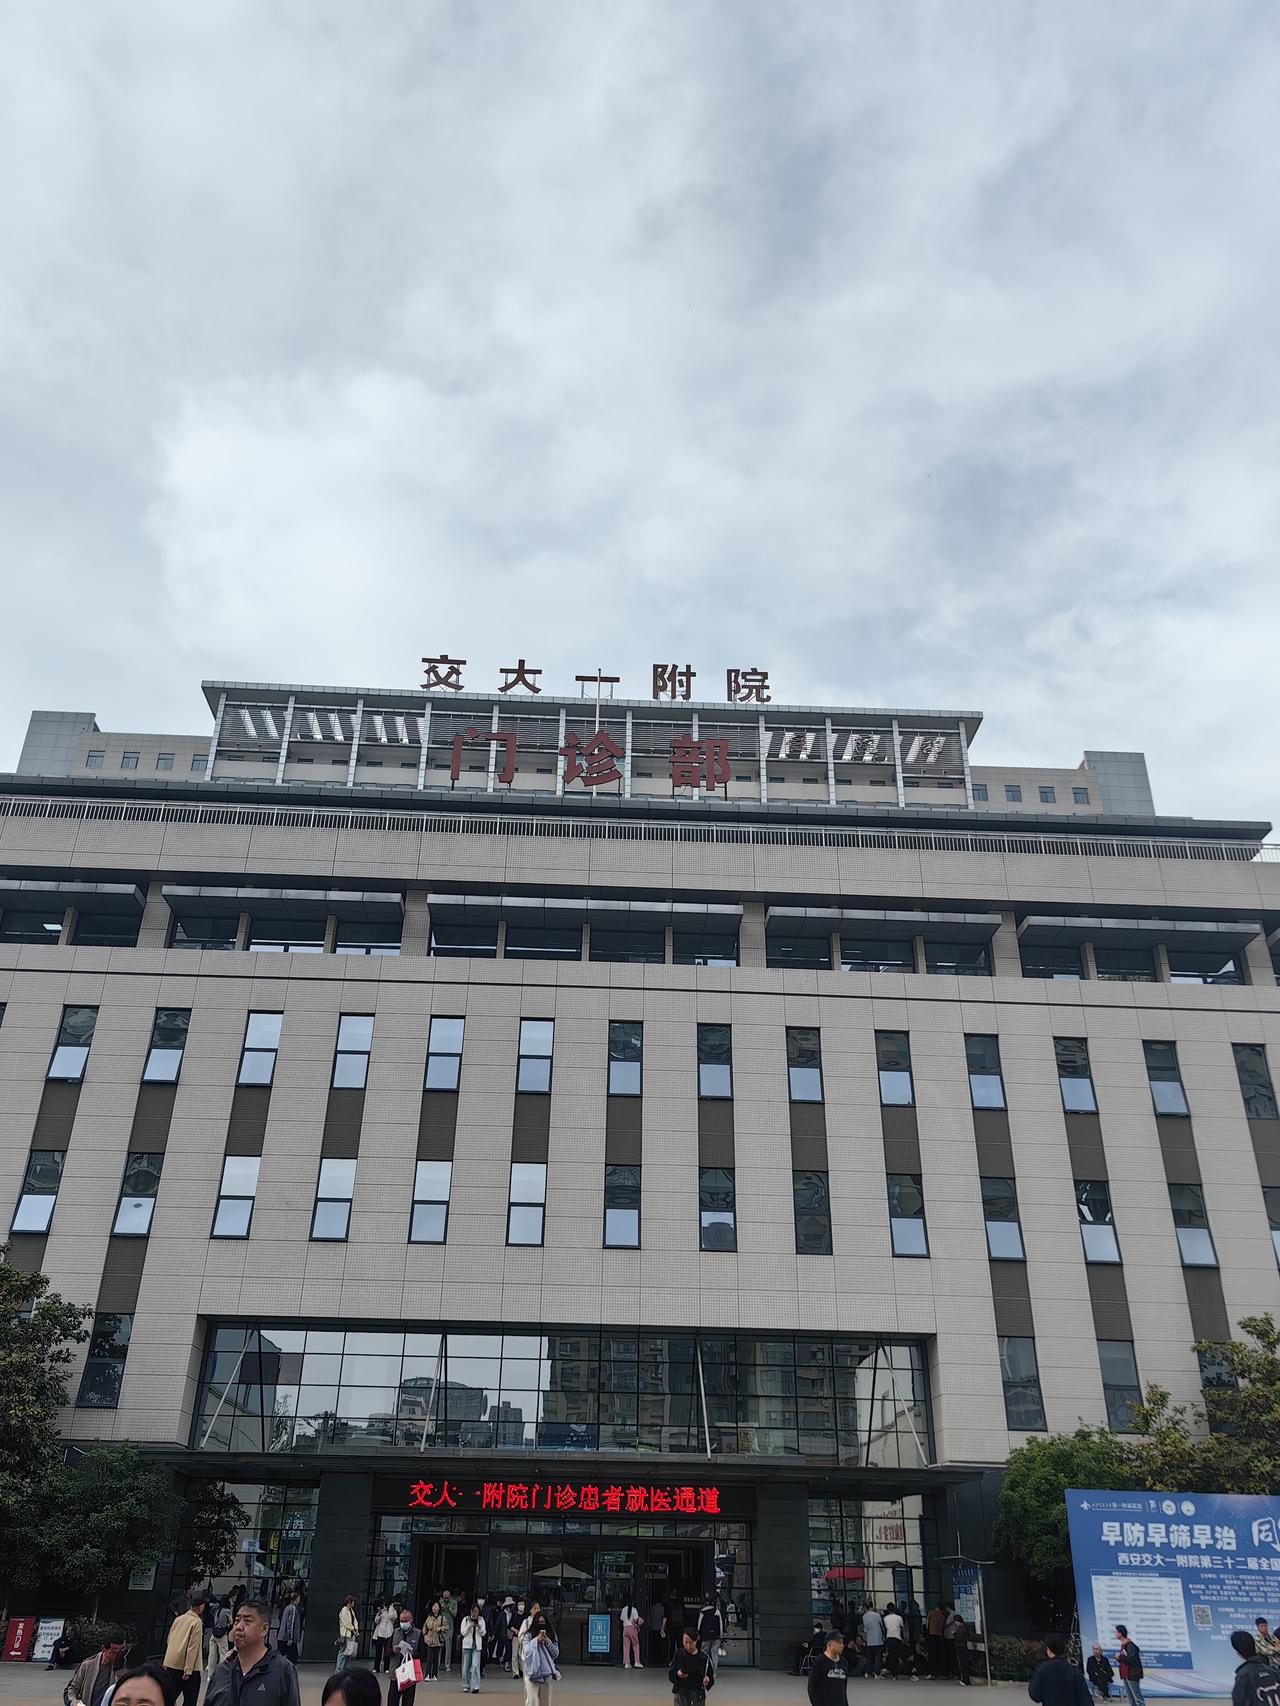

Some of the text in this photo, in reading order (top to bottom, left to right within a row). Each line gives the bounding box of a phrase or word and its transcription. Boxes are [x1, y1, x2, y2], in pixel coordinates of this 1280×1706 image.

[420, 654, 772, 703] 交大一附院
[451, 727, 730, 792] 门诊部
[1100, 1516, 1280, 1553] 早防早筛早治 同
